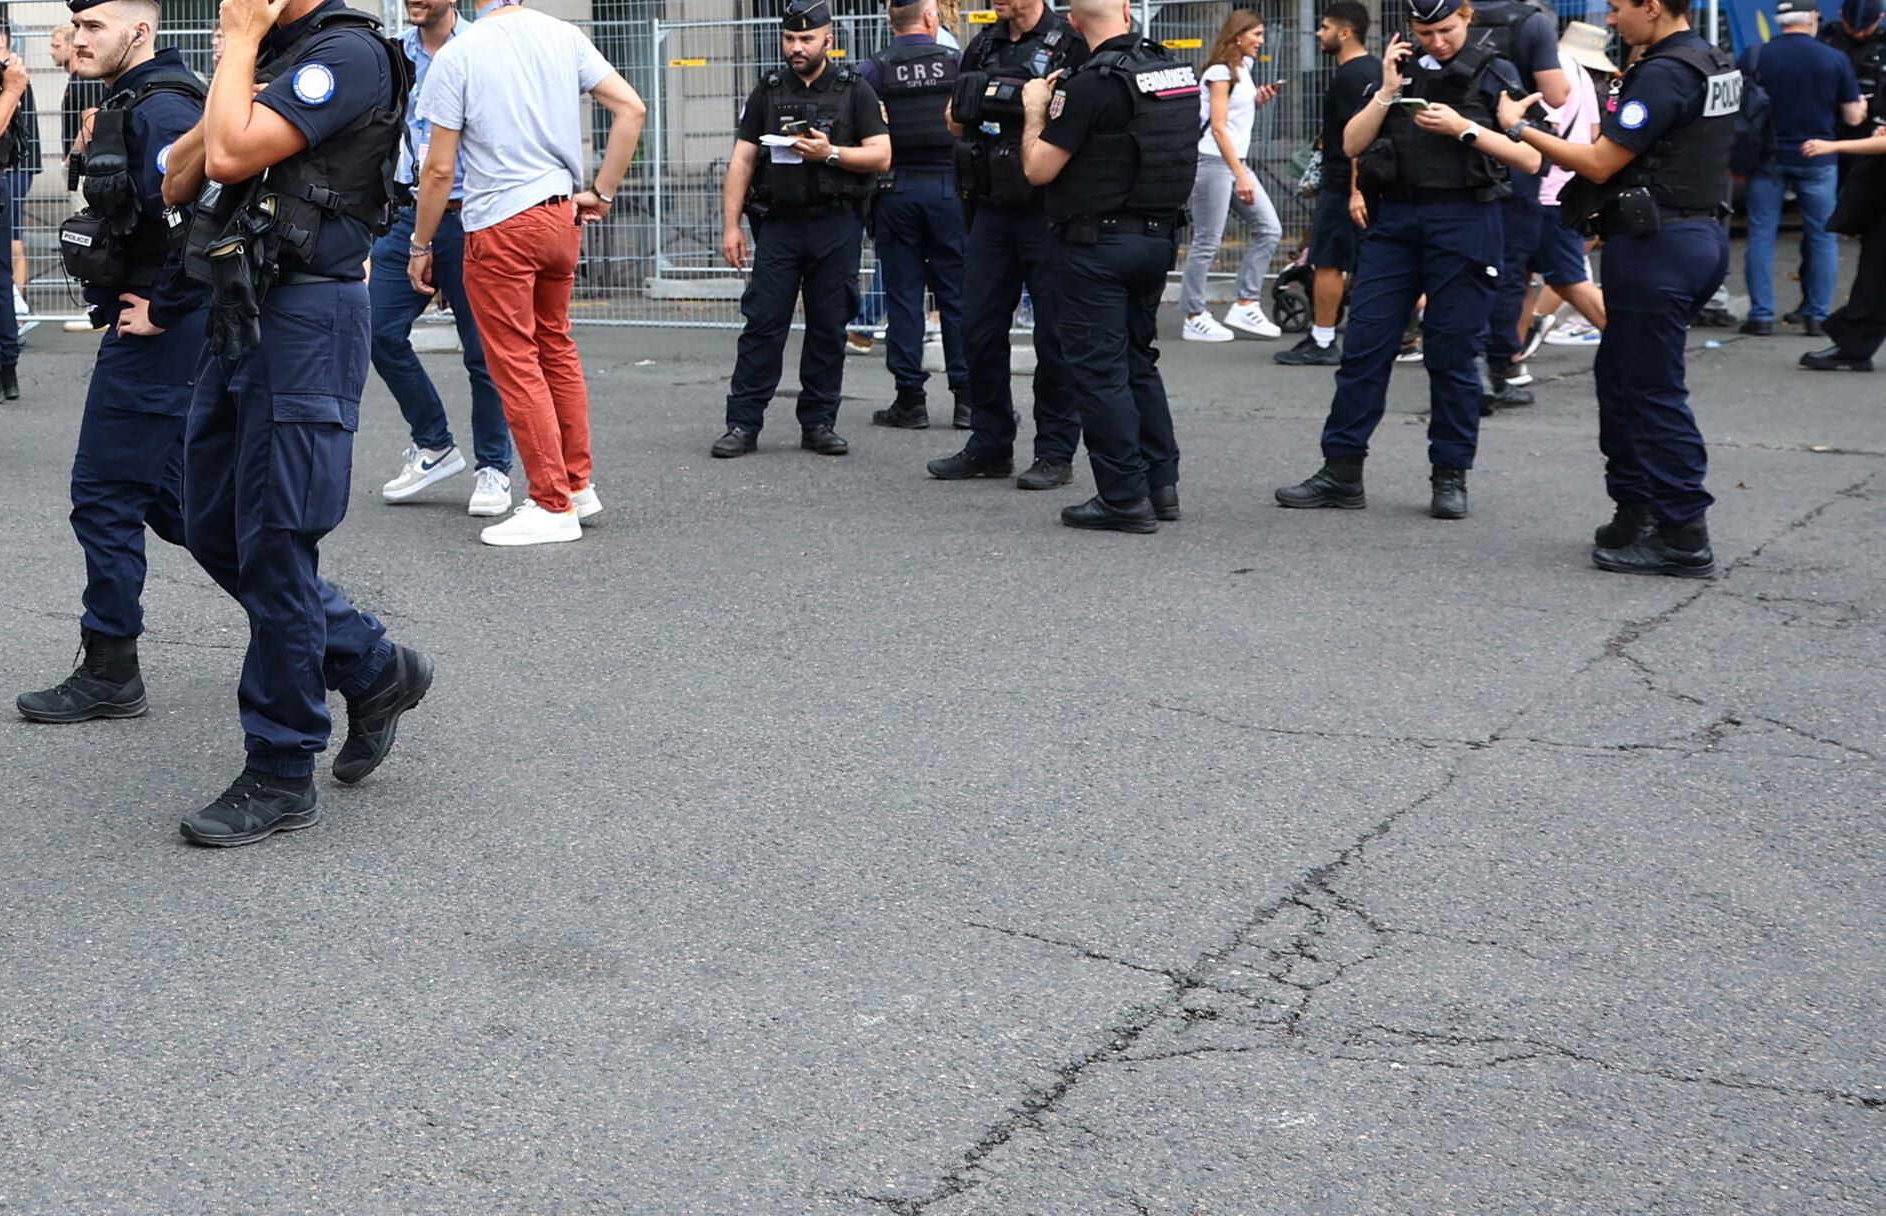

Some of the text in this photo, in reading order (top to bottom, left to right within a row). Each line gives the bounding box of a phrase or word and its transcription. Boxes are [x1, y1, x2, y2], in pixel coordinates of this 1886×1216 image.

[1136, 66, 1198, 94] GENDARMERIE
[1710, 76, 1743, 111] POLIC
[64, 232, 90, 244] POLICE
